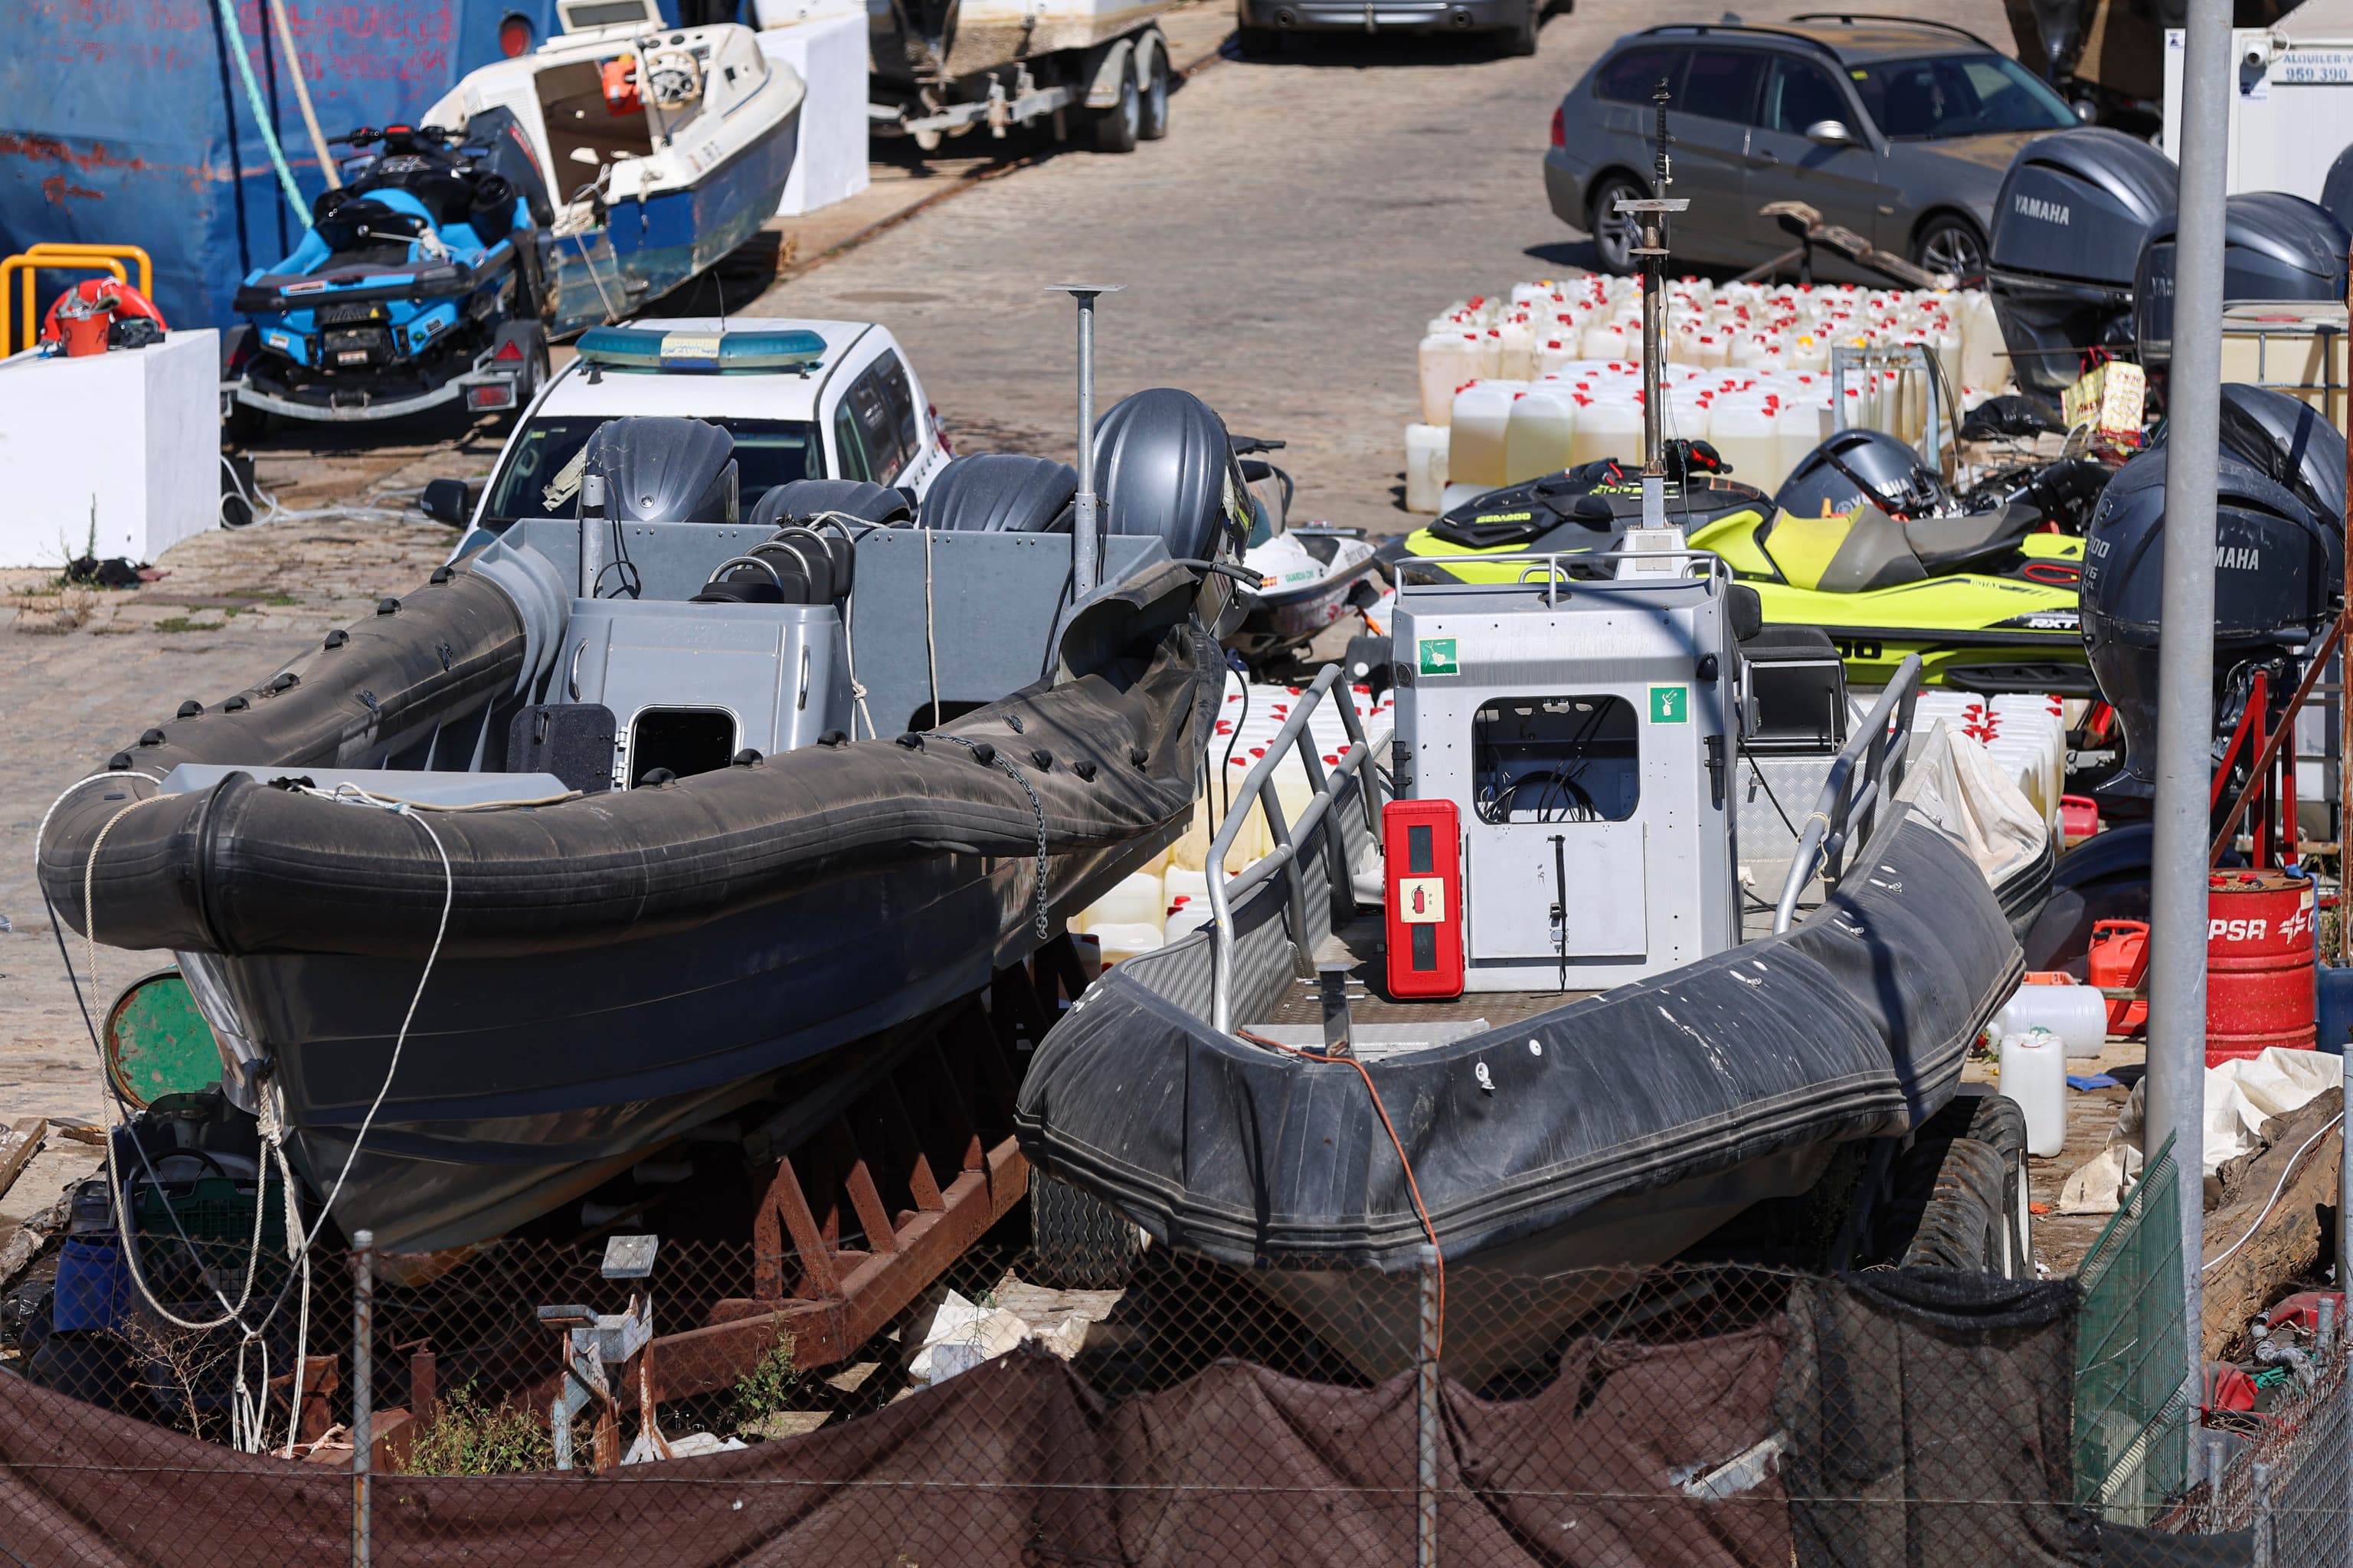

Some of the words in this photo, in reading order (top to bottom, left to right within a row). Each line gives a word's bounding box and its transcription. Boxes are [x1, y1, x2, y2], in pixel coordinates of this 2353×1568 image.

[2286, 67, 2314, 81] 959
[2320, 67, 2348, 81] 390
[2015, 194, 2070, 225] YAMAHA
[2214, 546, 2259, 571] MAHA
[2208, 918, 2267, 941] PSA
